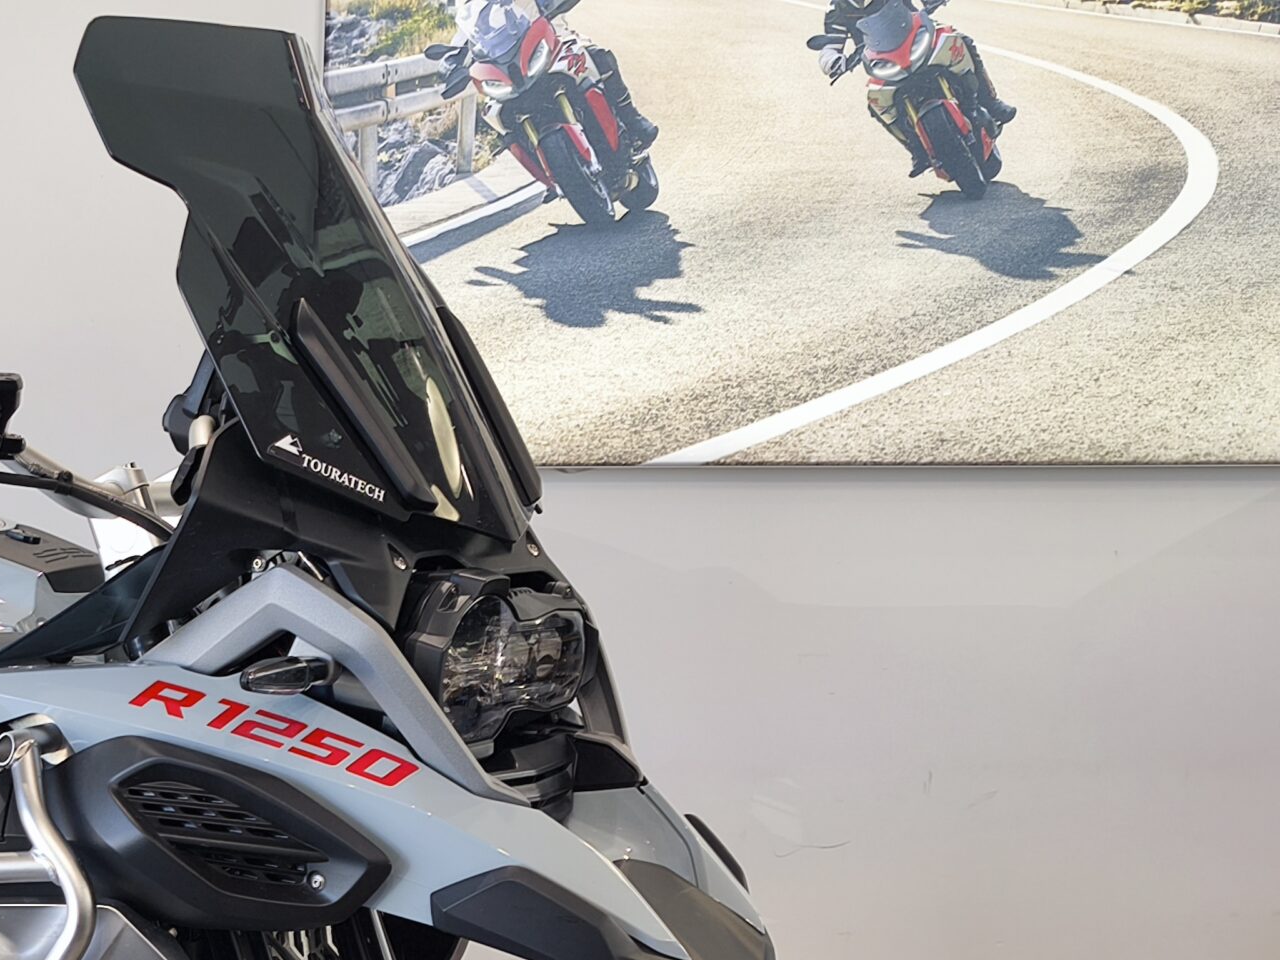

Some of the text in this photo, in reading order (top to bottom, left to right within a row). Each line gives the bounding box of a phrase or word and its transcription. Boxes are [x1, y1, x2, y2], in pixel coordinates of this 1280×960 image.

[301, 454, 386, 502] TOURATECH
[128, 679, 420, 787] R 1250
